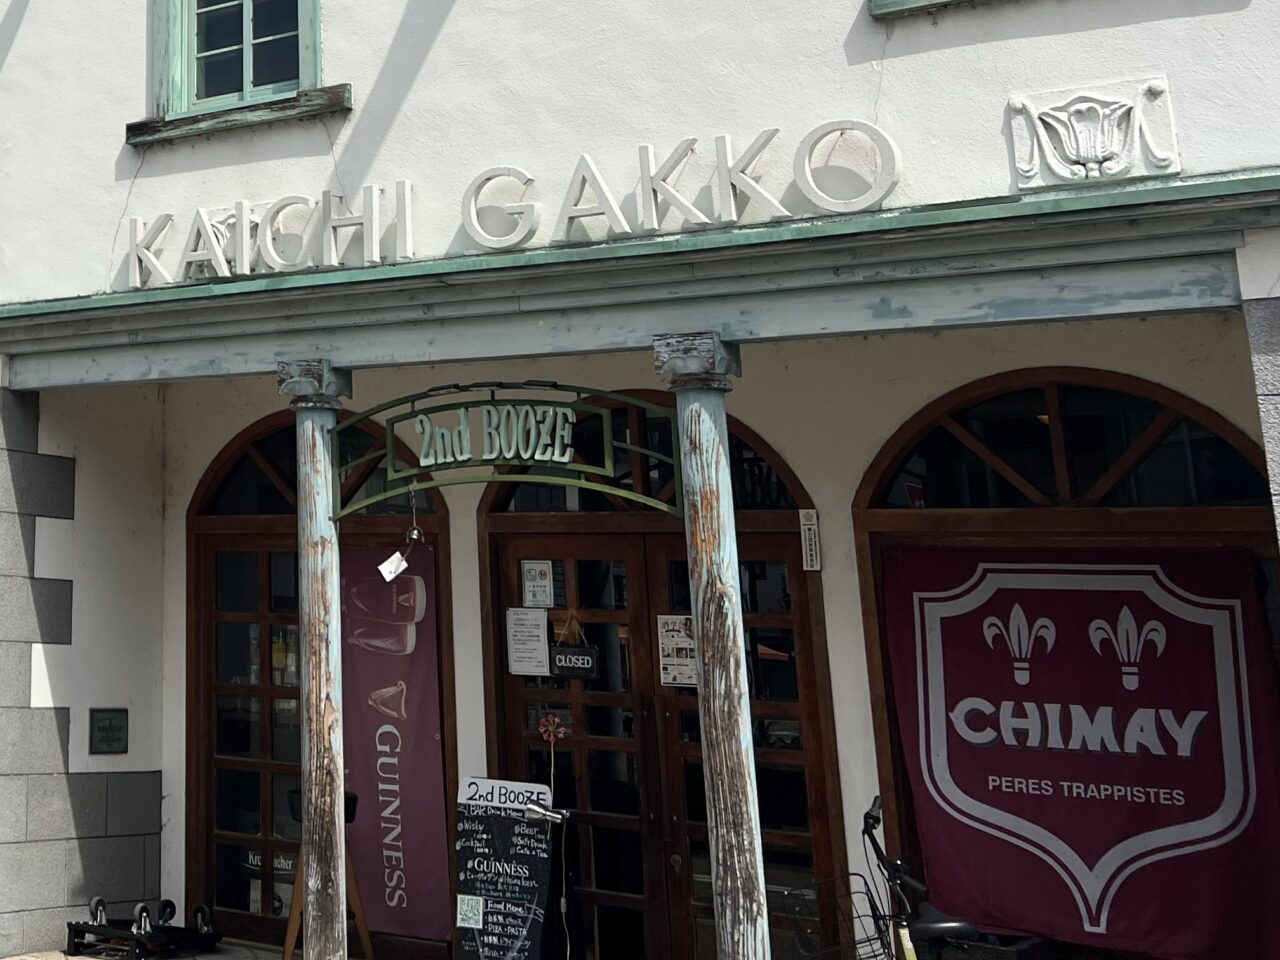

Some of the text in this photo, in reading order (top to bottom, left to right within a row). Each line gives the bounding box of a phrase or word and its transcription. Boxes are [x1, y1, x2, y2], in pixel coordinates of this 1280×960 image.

[129, 118, 901, 288] KAICHI GAKKO
[415, 403, 577, 468] 2nd BOOZE
[555, 654, 593, 669] CLOSED
[949, 697, 1208, 757] CHIMAY
[466, 781, 494, 803] 2nd
[988, 775, 1186, 807] PERES TRAPPISTES
[375, 724, 407, 908] GUINNESS
[474, 857, 529, 877] GUINNESS
